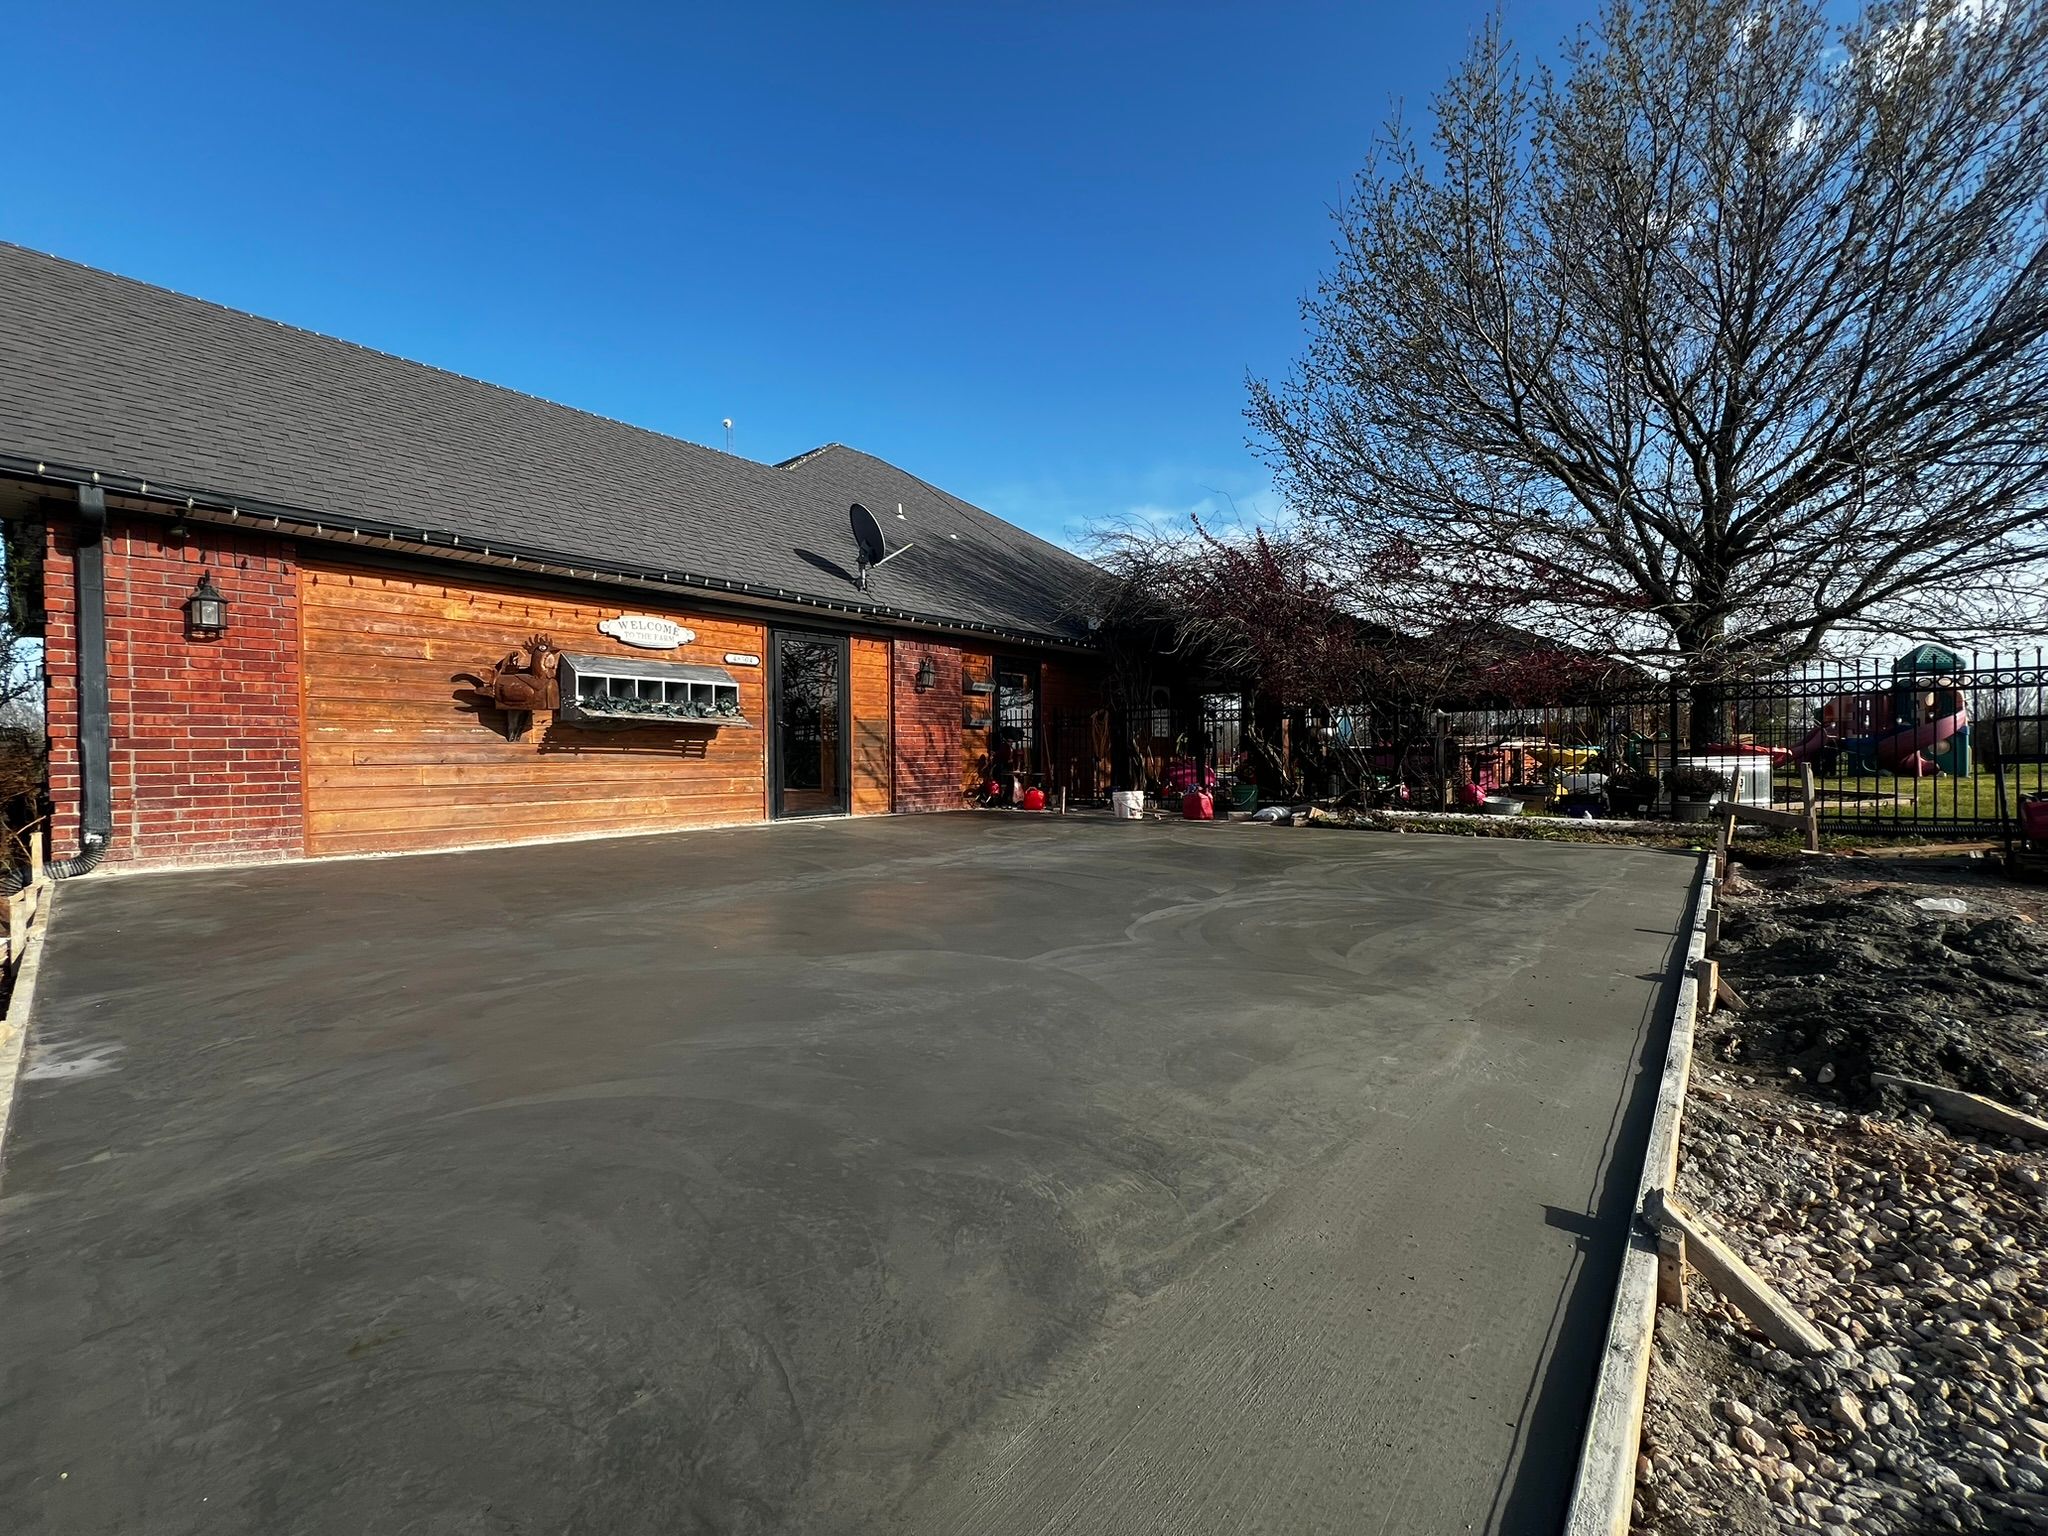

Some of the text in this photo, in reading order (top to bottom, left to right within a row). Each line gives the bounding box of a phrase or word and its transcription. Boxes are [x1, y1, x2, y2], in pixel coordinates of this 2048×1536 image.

[618, 620, 680, 637] WELCOME
[624, 631, 675, 643] TO THE FARM
